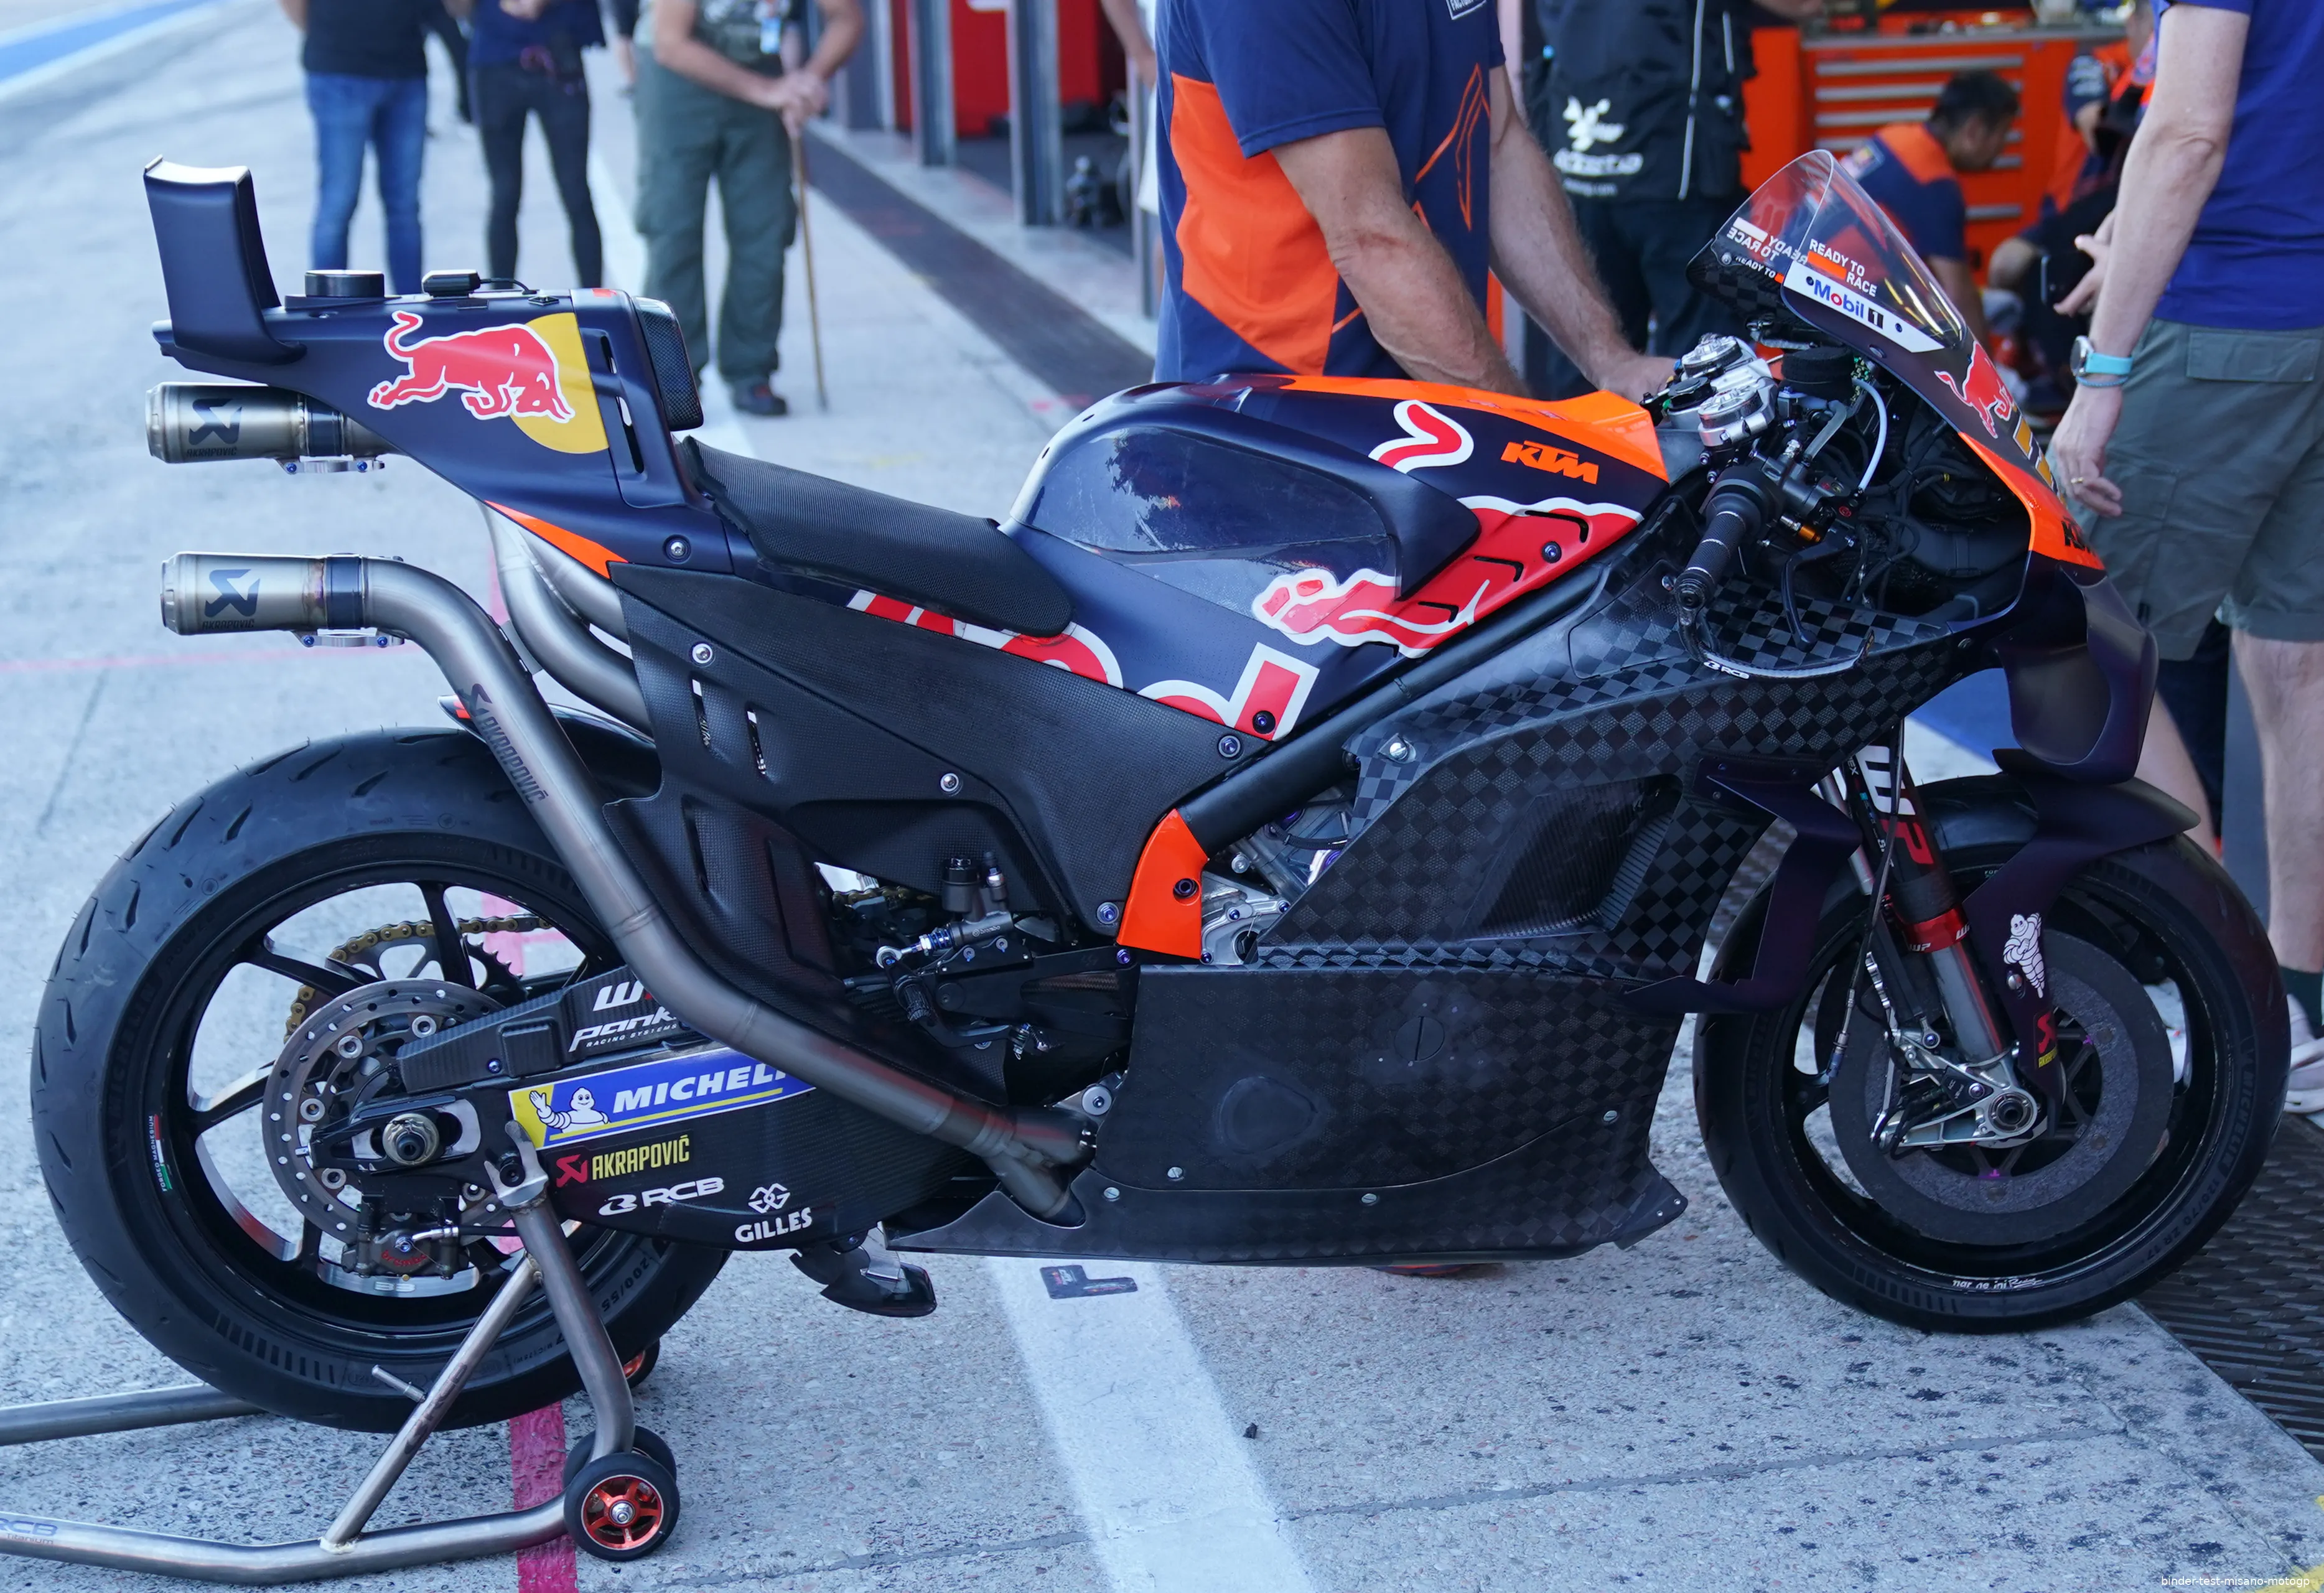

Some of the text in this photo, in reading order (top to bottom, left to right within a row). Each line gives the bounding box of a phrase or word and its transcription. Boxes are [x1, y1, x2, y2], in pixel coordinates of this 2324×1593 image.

[1764, 267, 1776, 279] TO
[1809, 238, 1865, 278] READY TO
[1814, 279, 1865, 319] Mobil
[1846, 271, 1878, 297] RACE
[1500, 440, 1600, 485] KTM
[592, 980, 653, 1012] W
[586, 1023, 678, 1048] RACING SYSTEMS
[592, 1134, 691, 1180] AKRAPOVIČ
[642, 1177, 725, 1208] RCB
[734, 1207, 813, 1243] GILLES
[601, 1257, 650, 1312] 200/55
